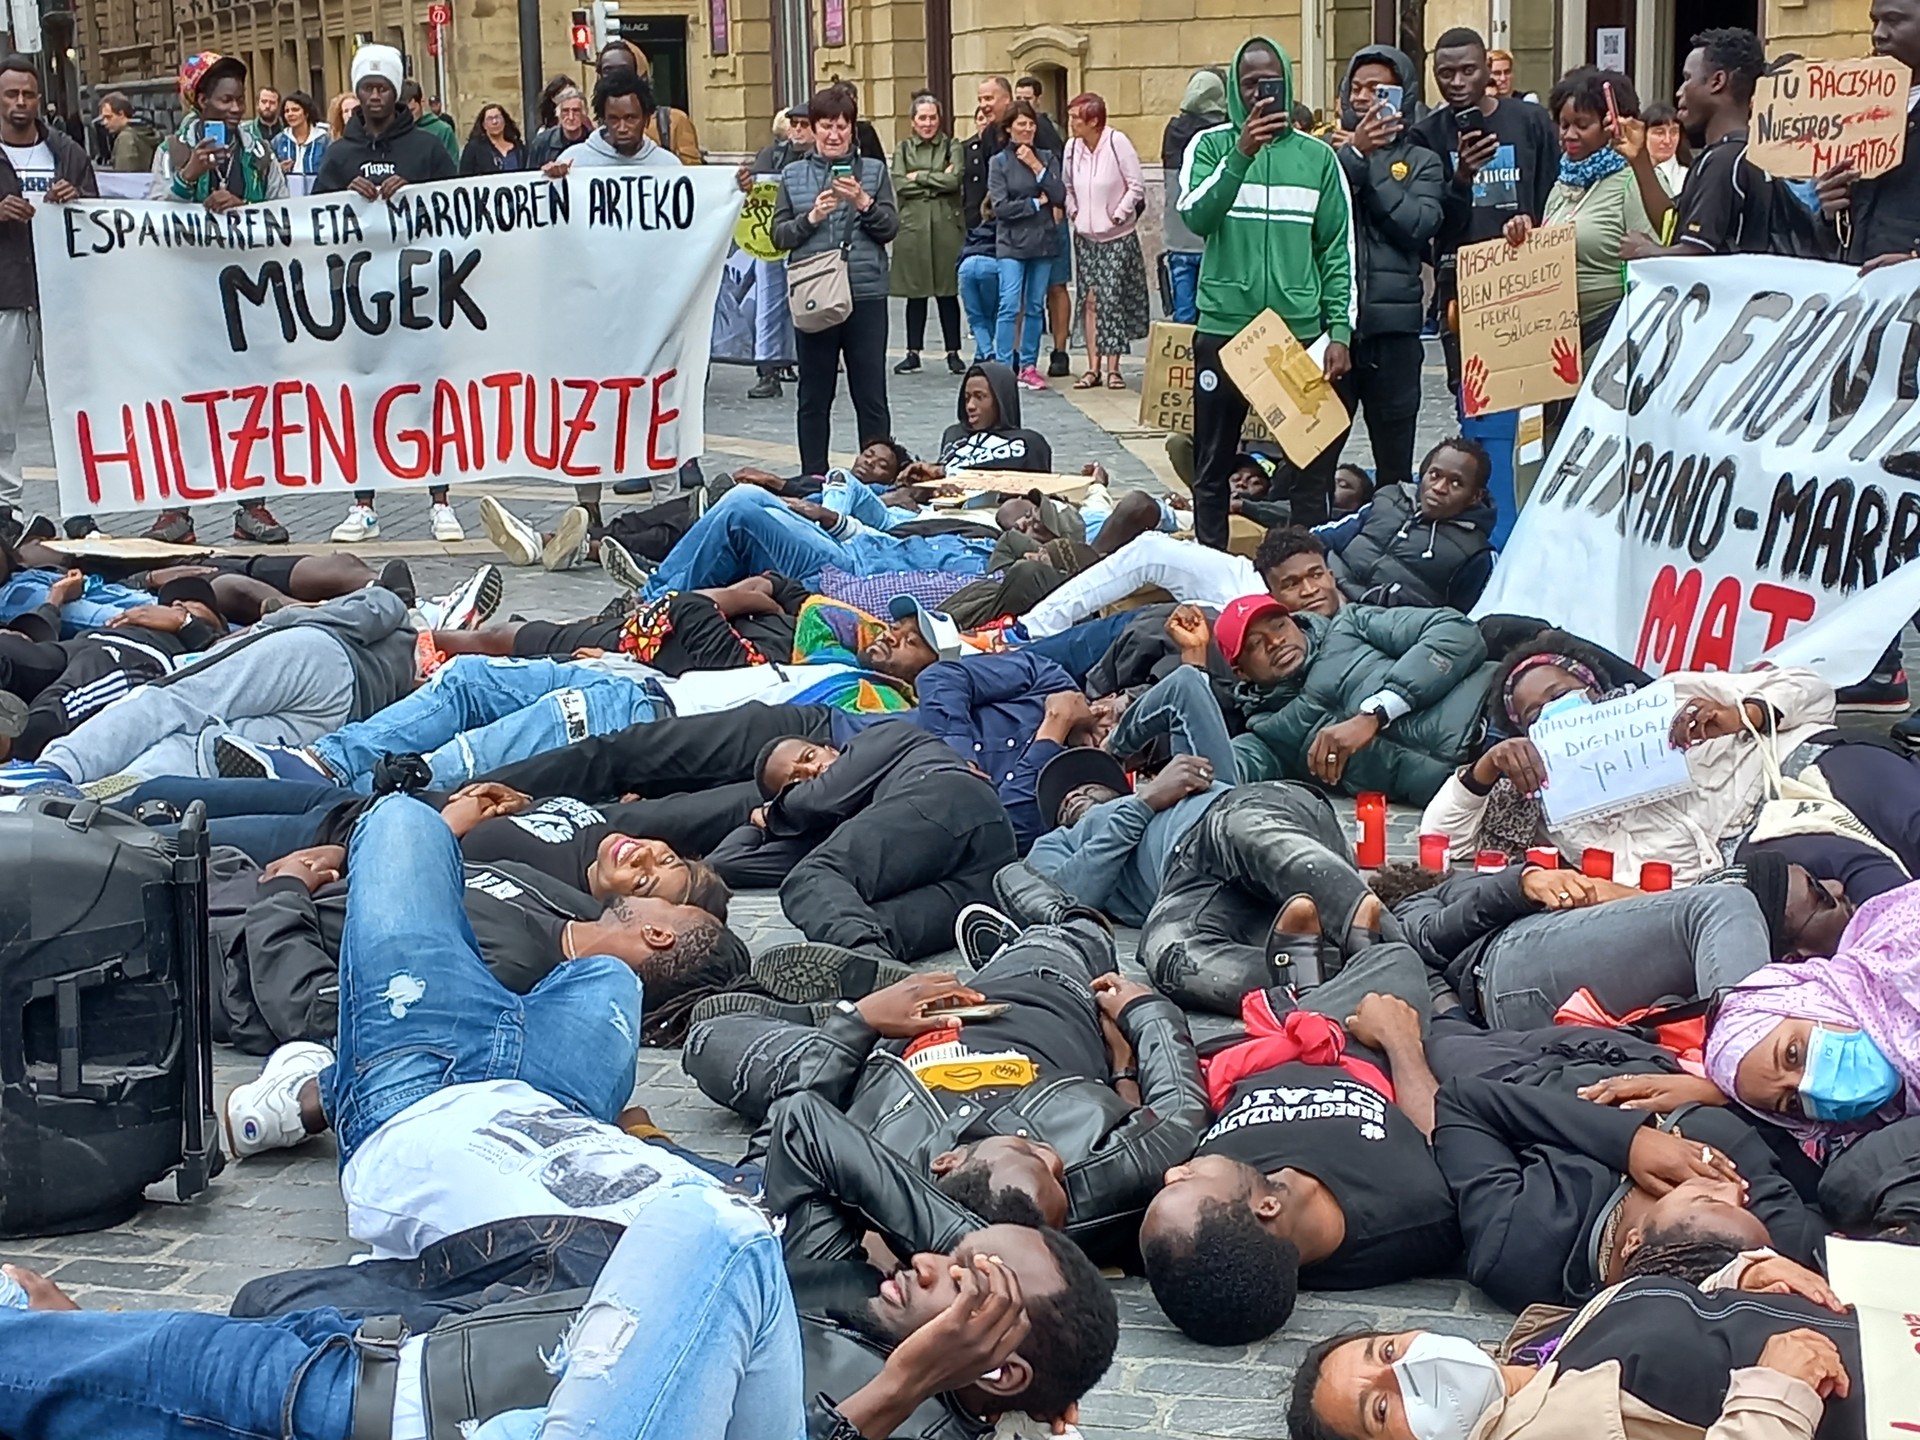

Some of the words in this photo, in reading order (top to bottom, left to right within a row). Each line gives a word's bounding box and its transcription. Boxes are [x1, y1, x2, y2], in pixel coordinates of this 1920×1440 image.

[621, 23, 649, 31] ALACE
[1769, 69, 1800, 100] TU
[1807, 65, 1897, 101] RACISMO
[1757, 103, 1844, 145] NUESTROS
[63, 204, 291, 259] ESPAINIAREN
[311, 203, 363, 246] ETA
[386, 176, 571, 244] MAROKOREN
[588, 175, 696, 231] ARTEKO
[1460, 242, 1519, 281] MASACRE
[219, 248, 488, 353] MUGEK
[1461, 281, 1492, 310] BIEN
[1499, 262, 1562, 299] RESUELTO
[77, 380, 359, 505] HILTZEN
[372, 367, 680, 480] GAITUZTE
